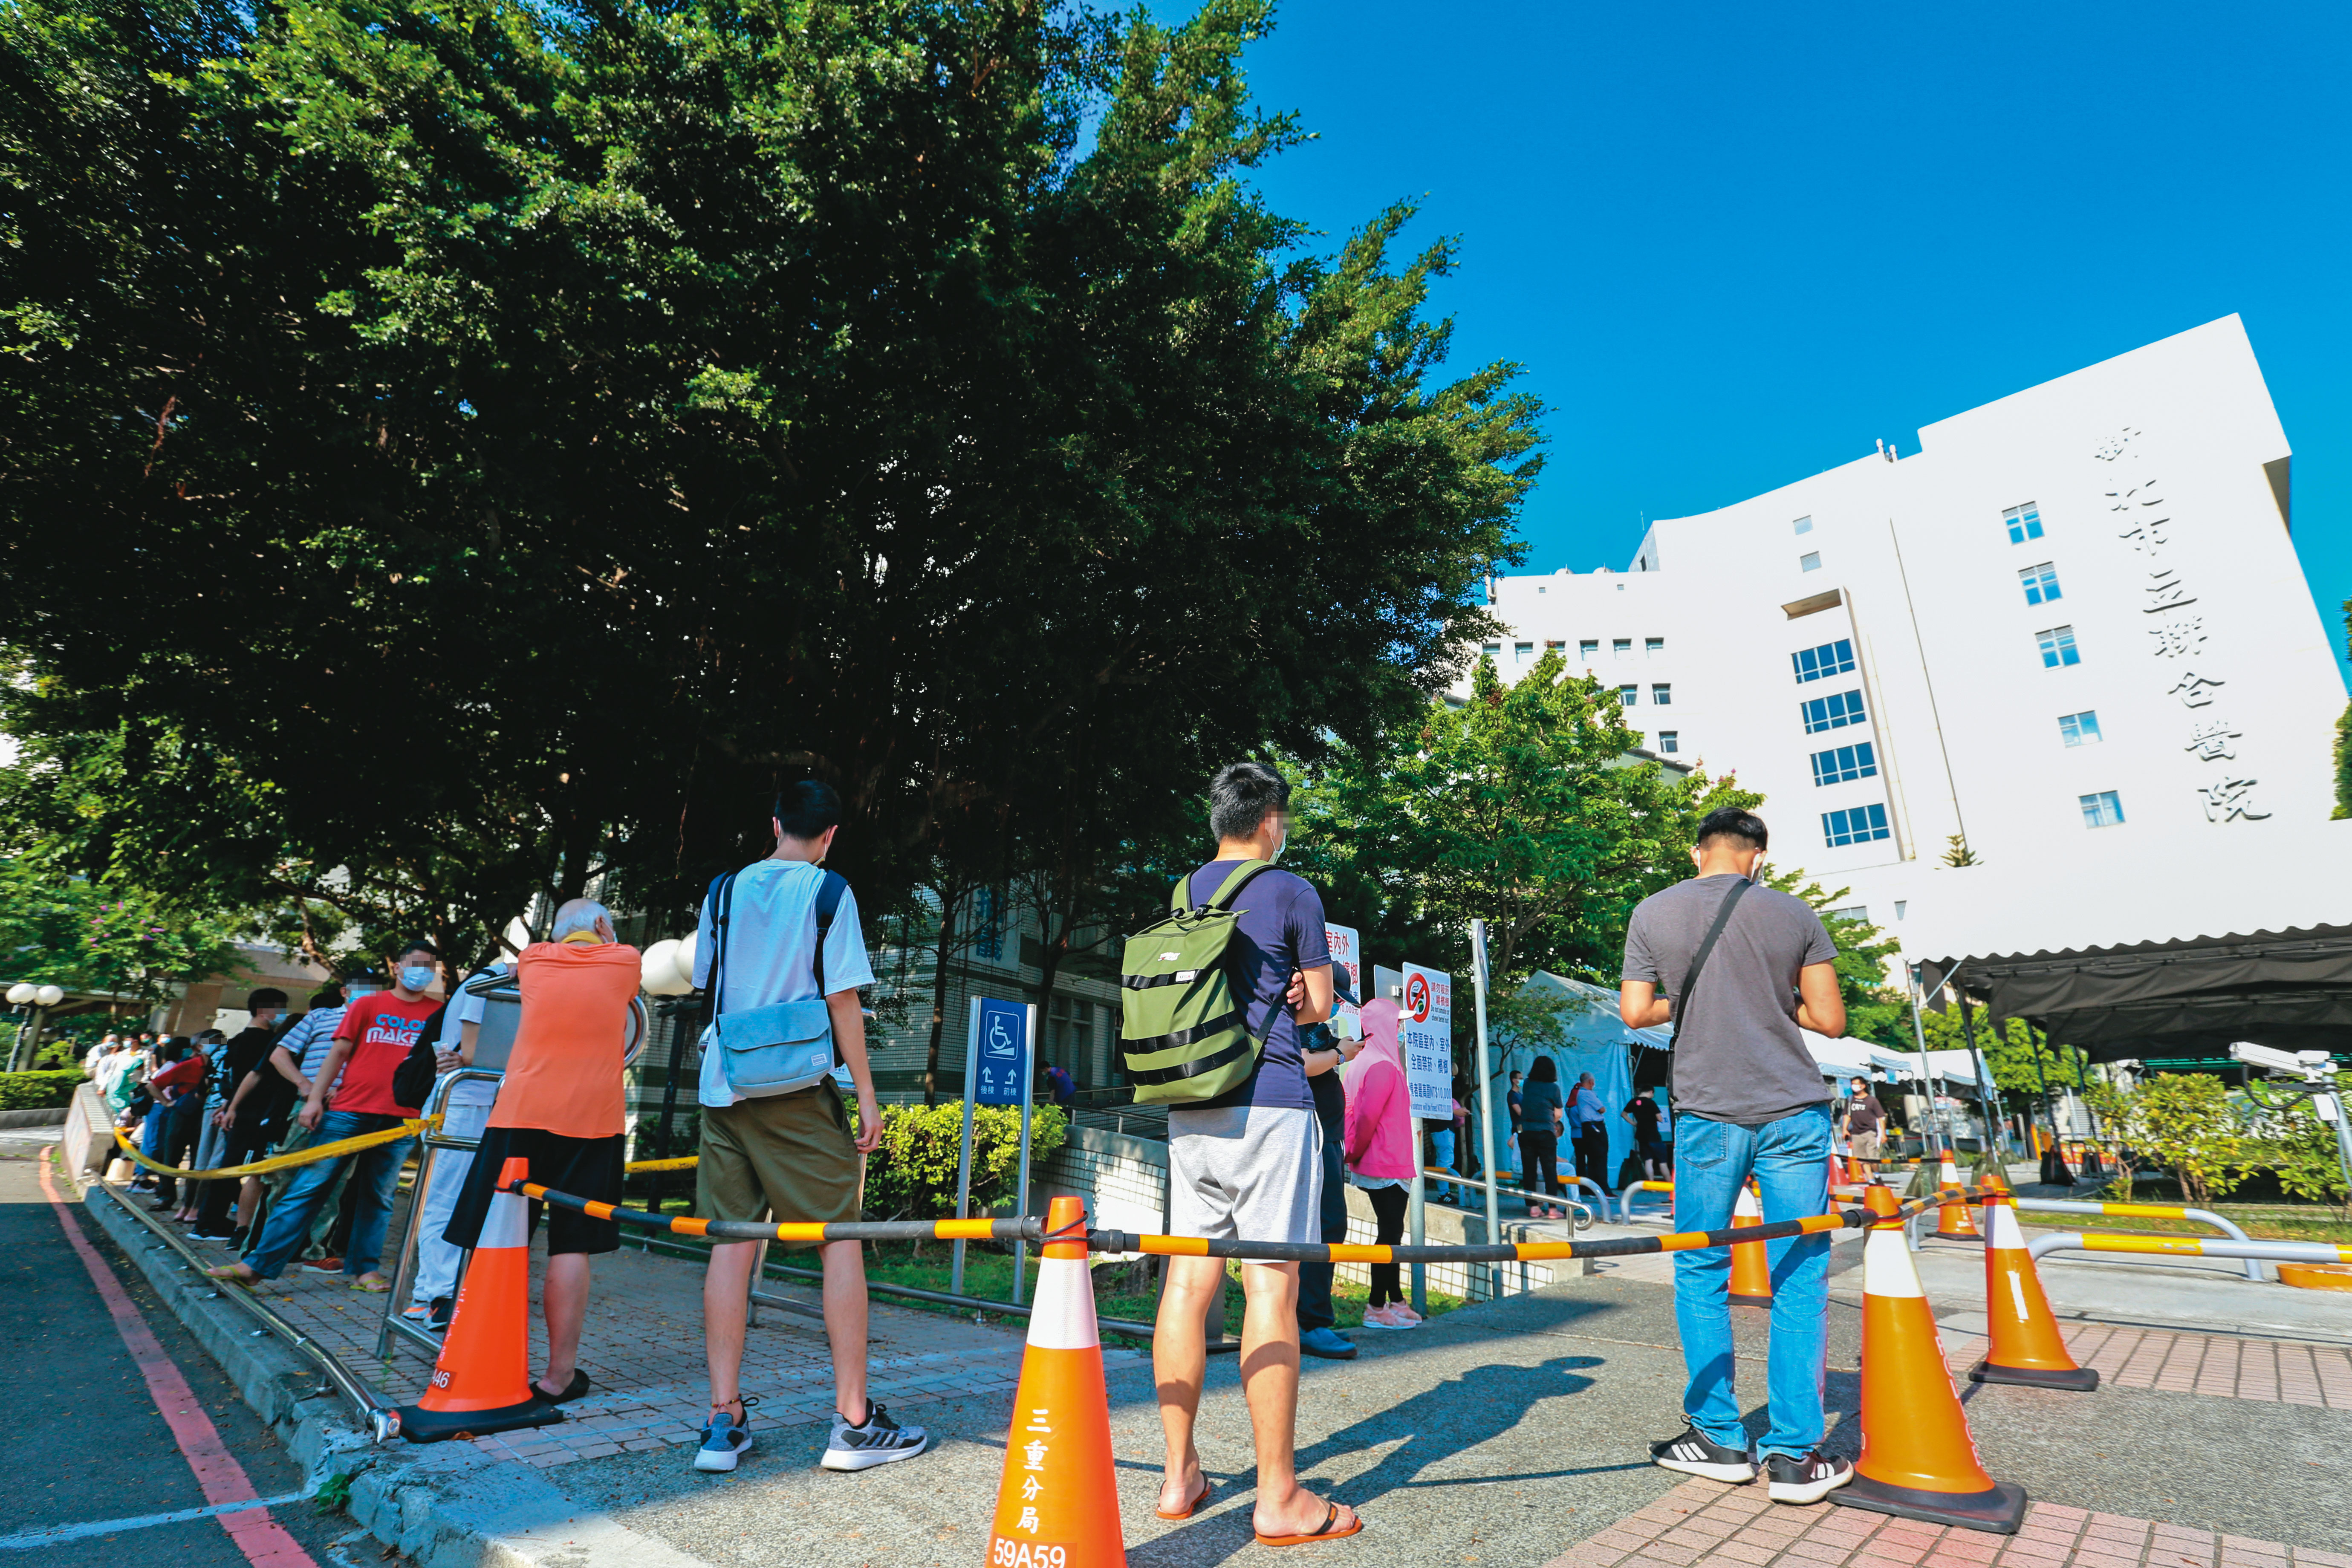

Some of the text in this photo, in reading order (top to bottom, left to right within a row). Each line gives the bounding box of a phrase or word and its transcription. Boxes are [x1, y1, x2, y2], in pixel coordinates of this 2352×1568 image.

[1431, 982, 1449, 995] 請勿吸菸
[1407, 1031, 1450, 1053] 本院區室內、室外
[1411, 1054, 1448, 1074] 全面禁菸、檳榔
[980, 1085, 1017, 1096] 後棟 前棟
[1016, 1408, 1051, 1534] 三重分局
[994, 1537, 1066, 1568] 59A59
